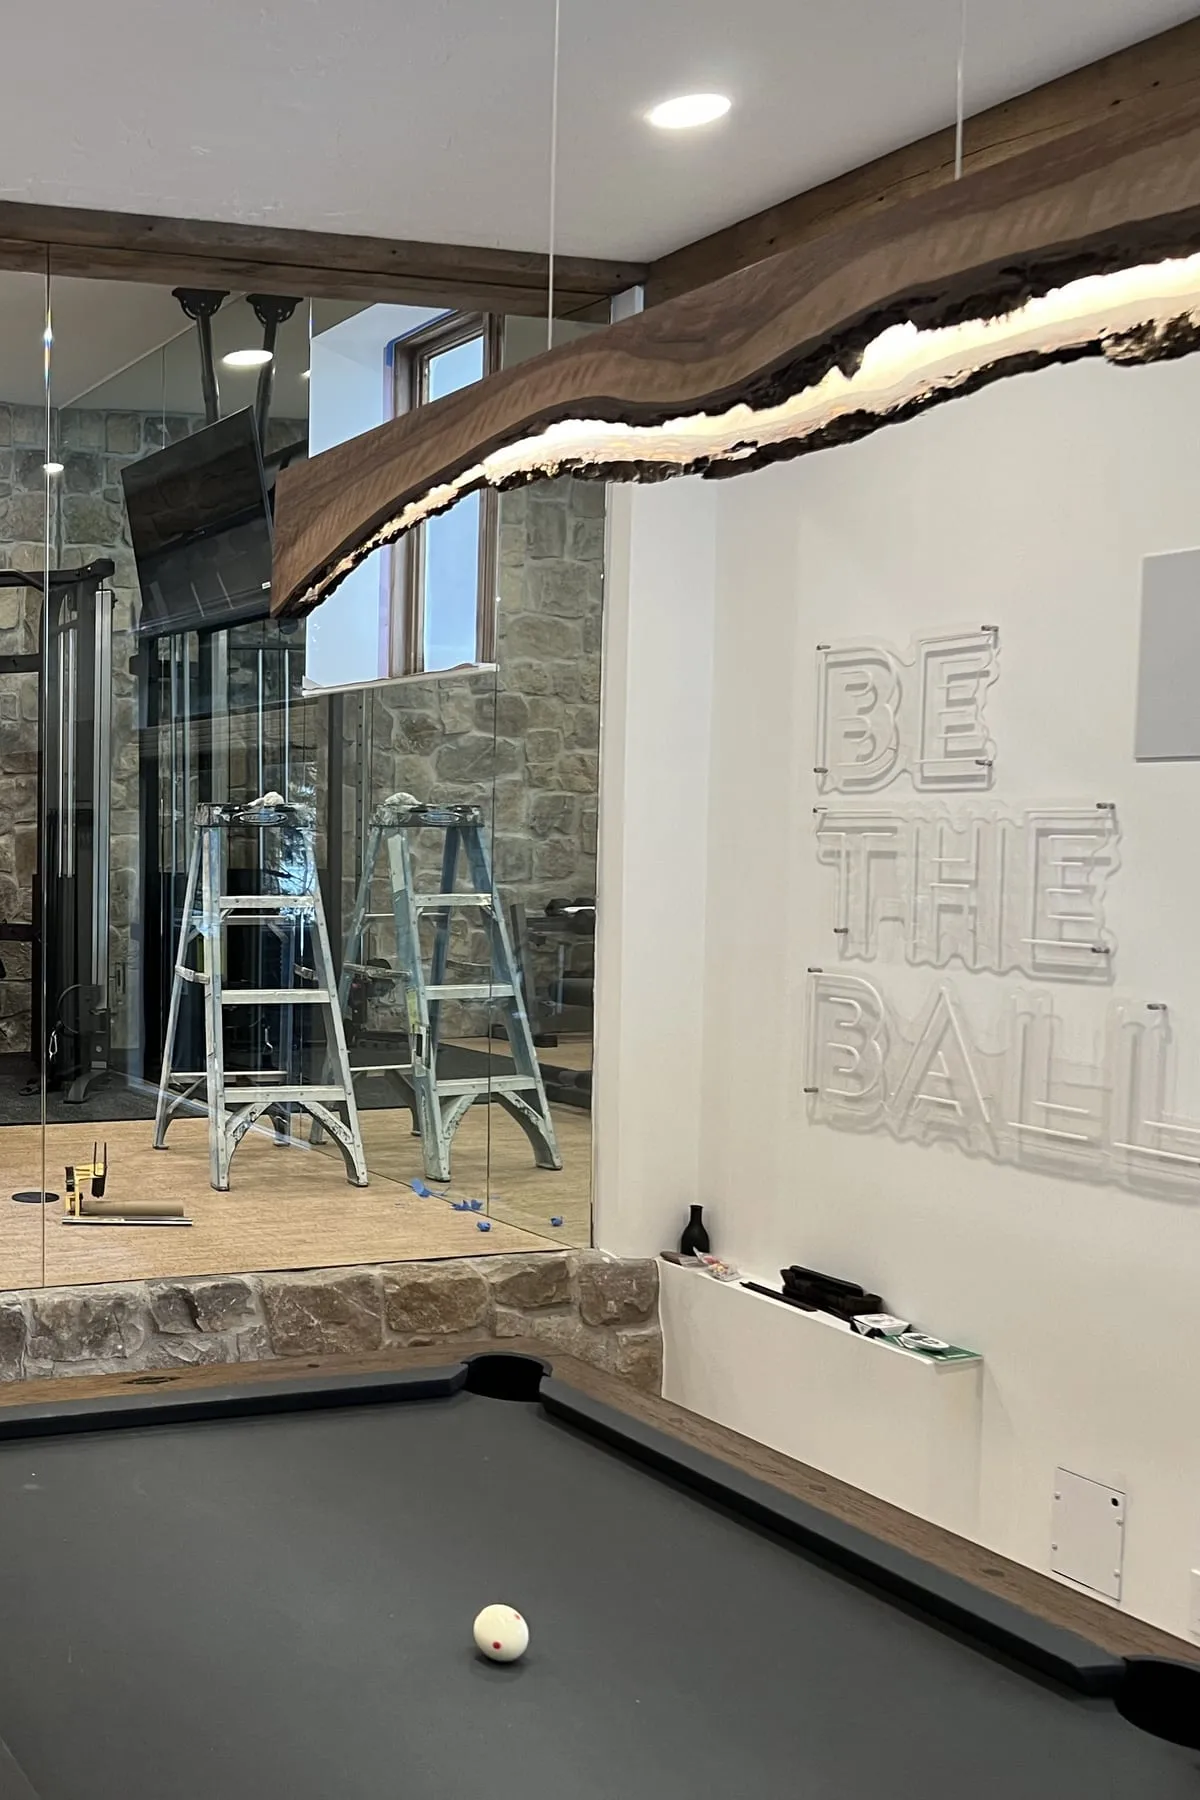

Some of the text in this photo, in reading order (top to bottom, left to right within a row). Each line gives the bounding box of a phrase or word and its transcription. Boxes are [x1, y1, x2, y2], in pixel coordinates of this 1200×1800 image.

[815, 629, 998, 786] BE
[815, 806, 1117, 972] THE
[806, 971, 1200, 1172] BALL
